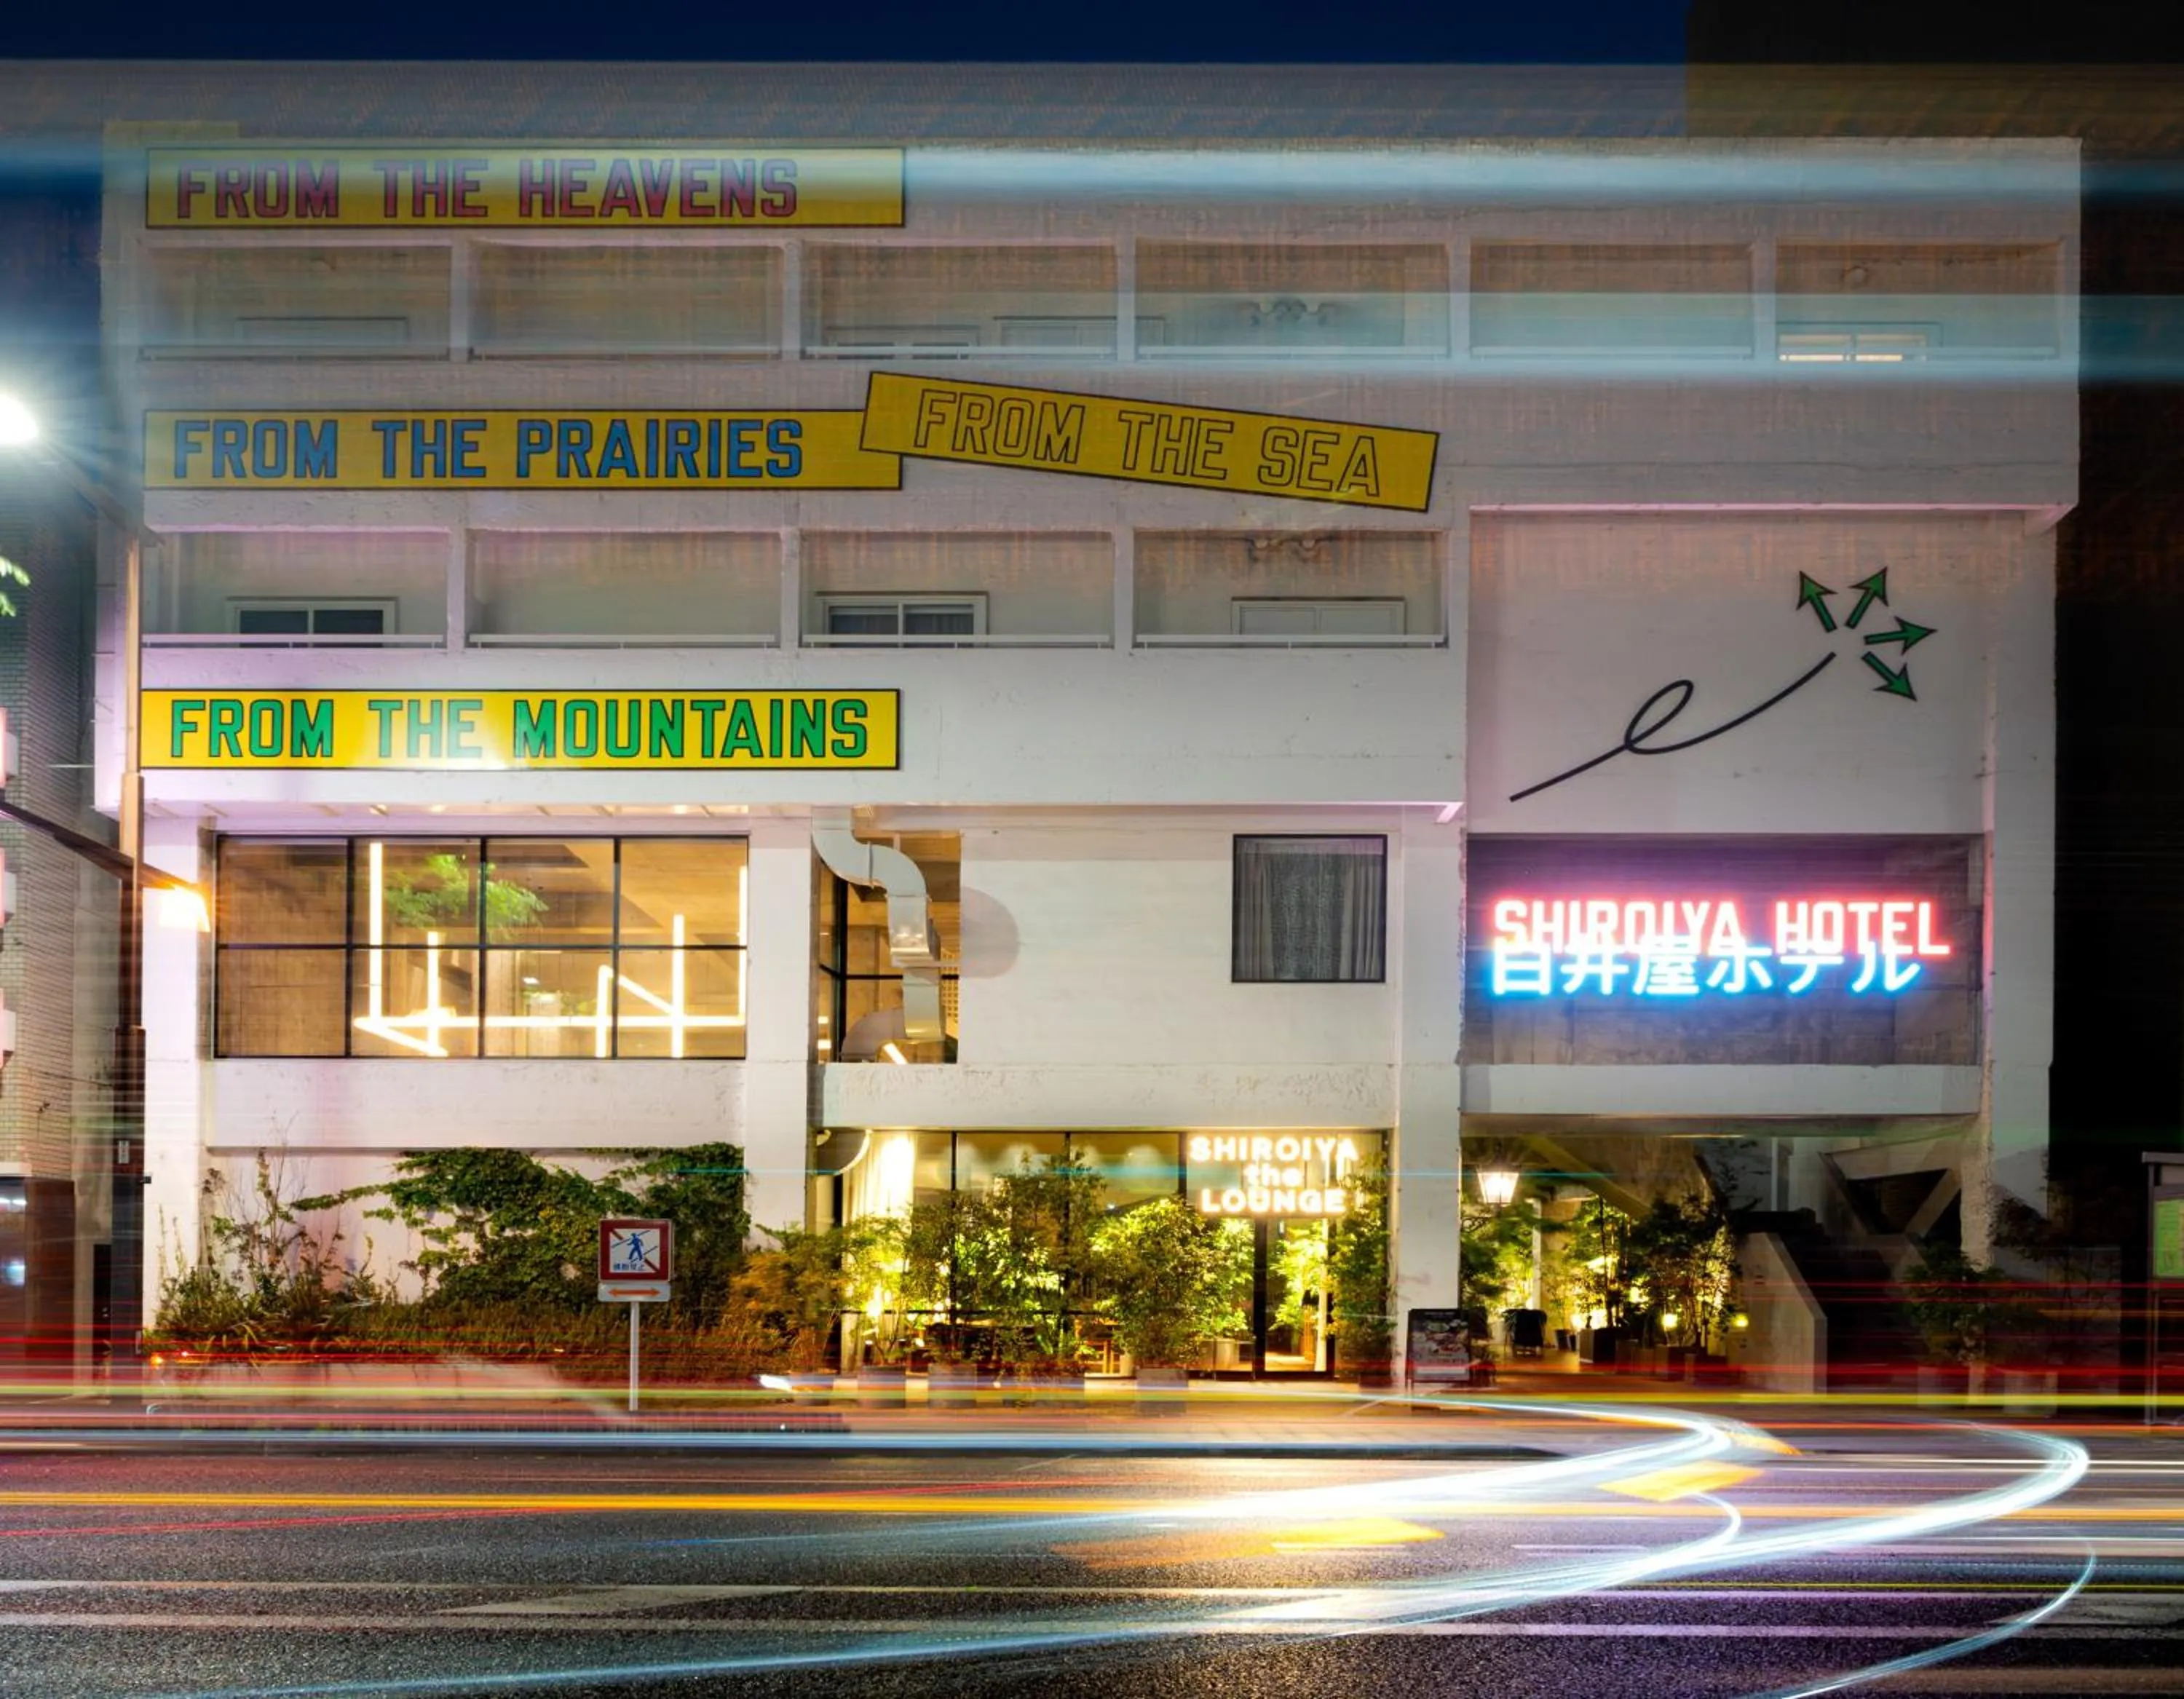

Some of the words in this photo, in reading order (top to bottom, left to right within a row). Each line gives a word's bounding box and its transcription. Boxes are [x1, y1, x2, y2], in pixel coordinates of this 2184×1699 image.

[178, 159, 339, 219] FROM
[373, 159, 488, 218] THE
[518, 159, 799, 218] HEAVENS
[173, 419, 338, 478] FROM
[372, 419, 487, 478] THE
[515, 419, 803, 478] PRAIRIES
[914, 389, 1085, 464] FROM
[1118, 410, 1234, 480] THE
[1257, 427, 1380, 496] SEA
[170, 699, 334, 758] FROM
[368, 699, 483, 758] THE
[513, 699, 867, 758] MOUNTAINS
[1492, 900, 1746, 954] SHIROIYA
[1775, 901, 1951, 955] HOTEL
[1492, 935, 1920, 995] 白井屋ホテル
[1190, 1136, 1358, 1162] SHIROIYA
[1201, 1188, 1346, 1213] LOUNGE
